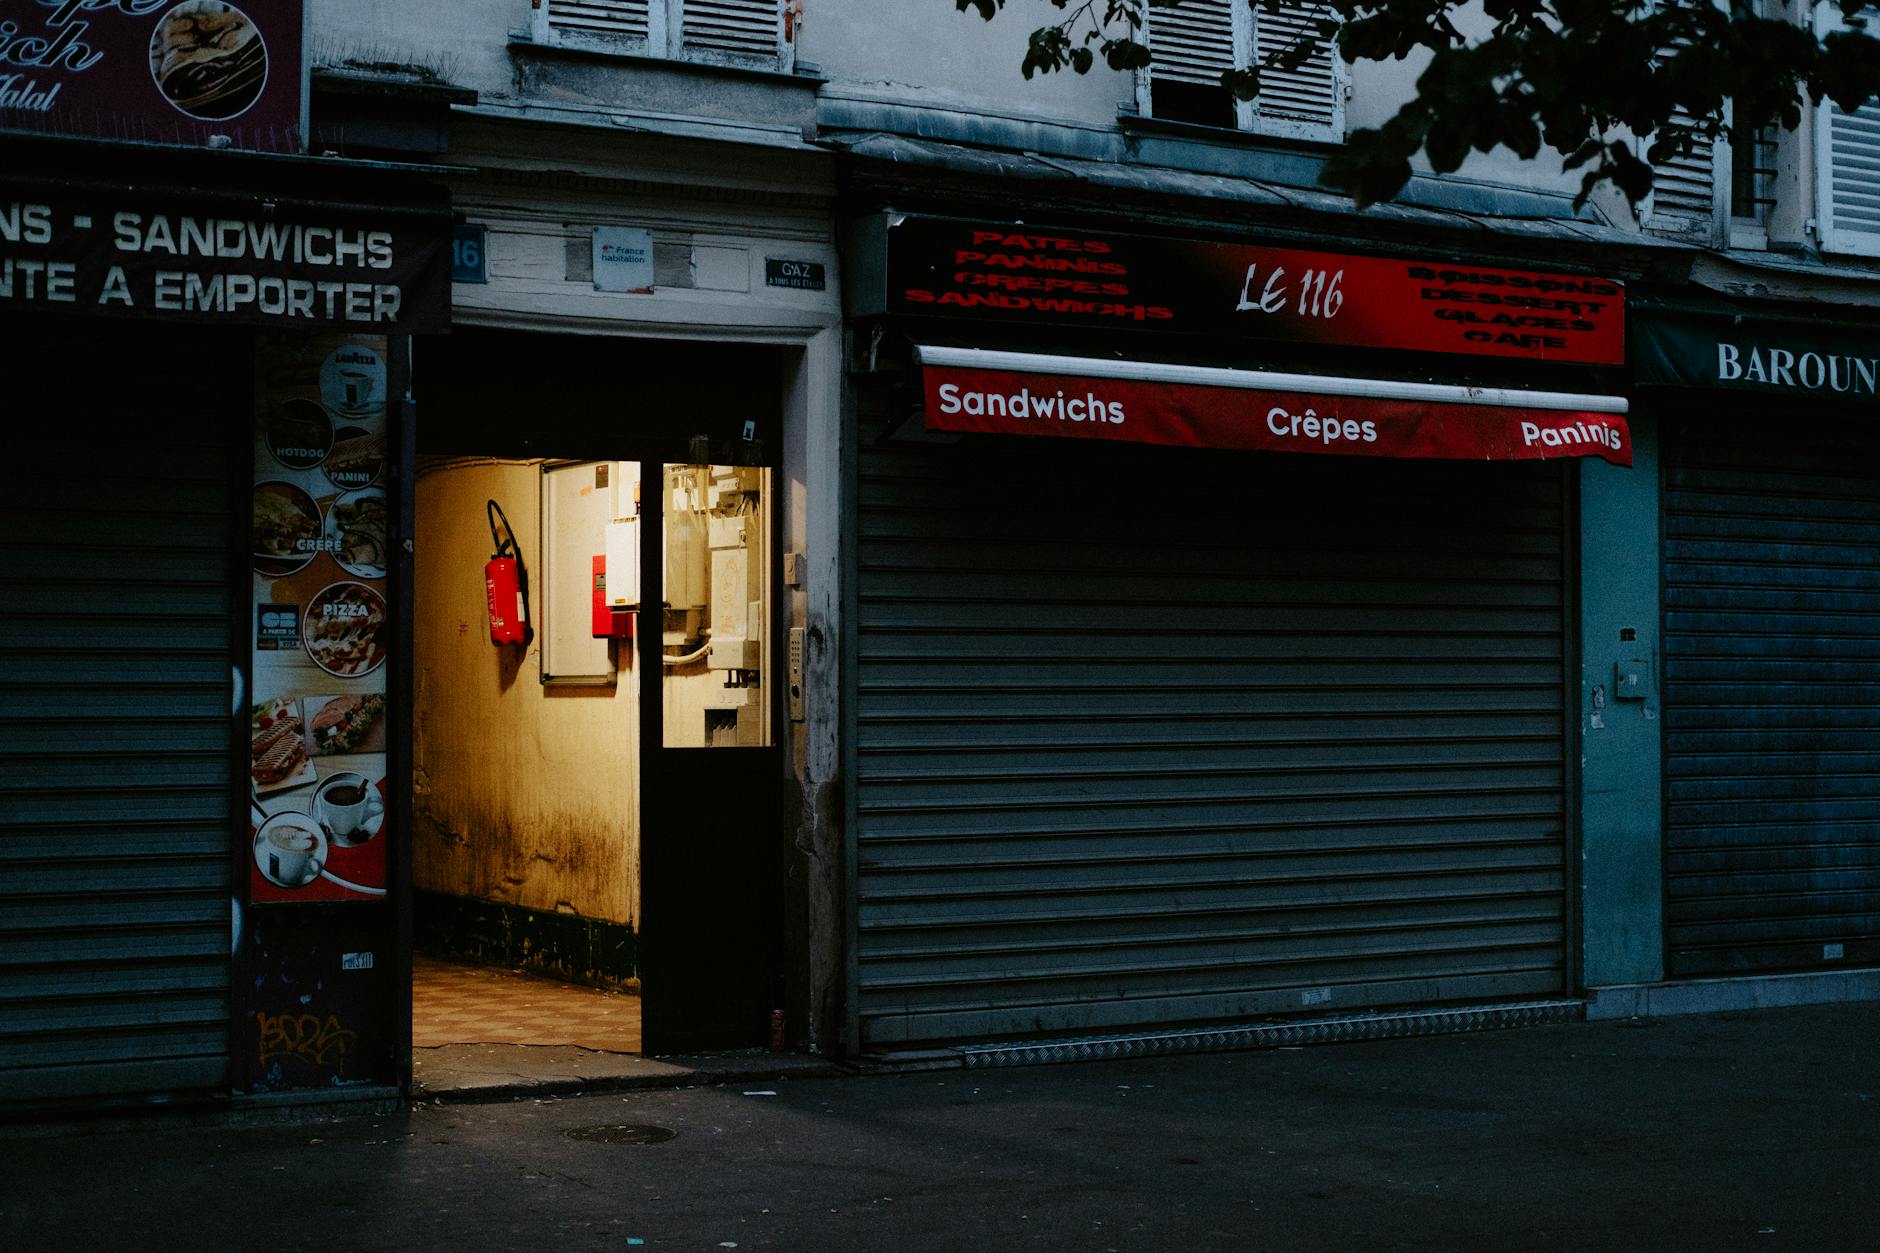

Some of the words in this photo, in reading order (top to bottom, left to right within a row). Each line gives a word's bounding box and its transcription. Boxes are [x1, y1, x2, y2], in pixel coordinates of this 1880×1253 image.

[112, 210, 394, 270] SANDWICHS
[616, 246, 645, 255] France
[972, 230, 1112, 254] PATES
[601, 254, 645, 263] habitation
[782, 262, 811, 277] GAZ
[953, 271, 1131, 296] CREPES
[1236, 263, 1288, 314] LE
[1298, 268, 1344, 318] 116
[1407, 266, 1620, 296] BOISSONS
[98, 265, 135, 307] A
[154, 269, 401, 323] EMPORTER
[903, 288, 1175, 320] SANDWICHS
[1420, 286, 1608, 315] DESSERT
[1433, 308, 1595, 332] GLACES
[1463, 330, 1568, 349] CAFE
[1716, 342, 1880, 395] BAROUN
[938, 383, 1126, 425] Sandwichs
[1266, 407, 1378, 445] Crêpes
[1521, 421, 1622, 450] Paninis
[276, 447, 325, 458] HOTDOG
[330, 471, 370, 482] PANINI
[322, 603, 369, 617] PIZZA
